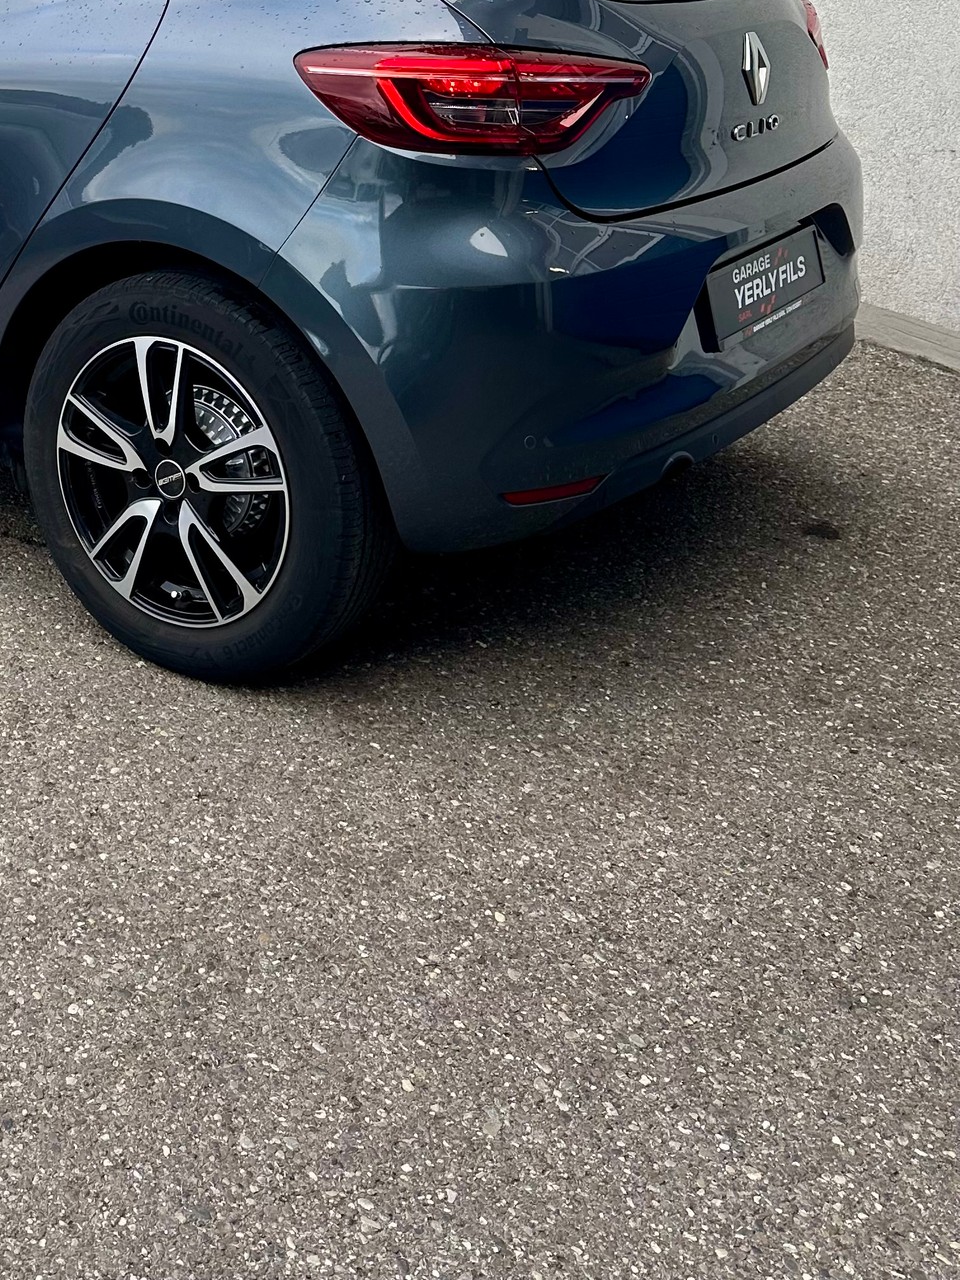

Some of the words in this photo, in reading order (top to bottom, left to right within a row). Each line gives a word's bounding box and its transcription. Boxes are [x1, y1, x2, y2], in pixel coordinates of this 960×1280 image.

[730, 113, 780, 142] CLIO
[732, 254, 771, 283] GARAGE
[734, 269, 778, 309] YERLY
[778, 255, 806, 287] FILS
